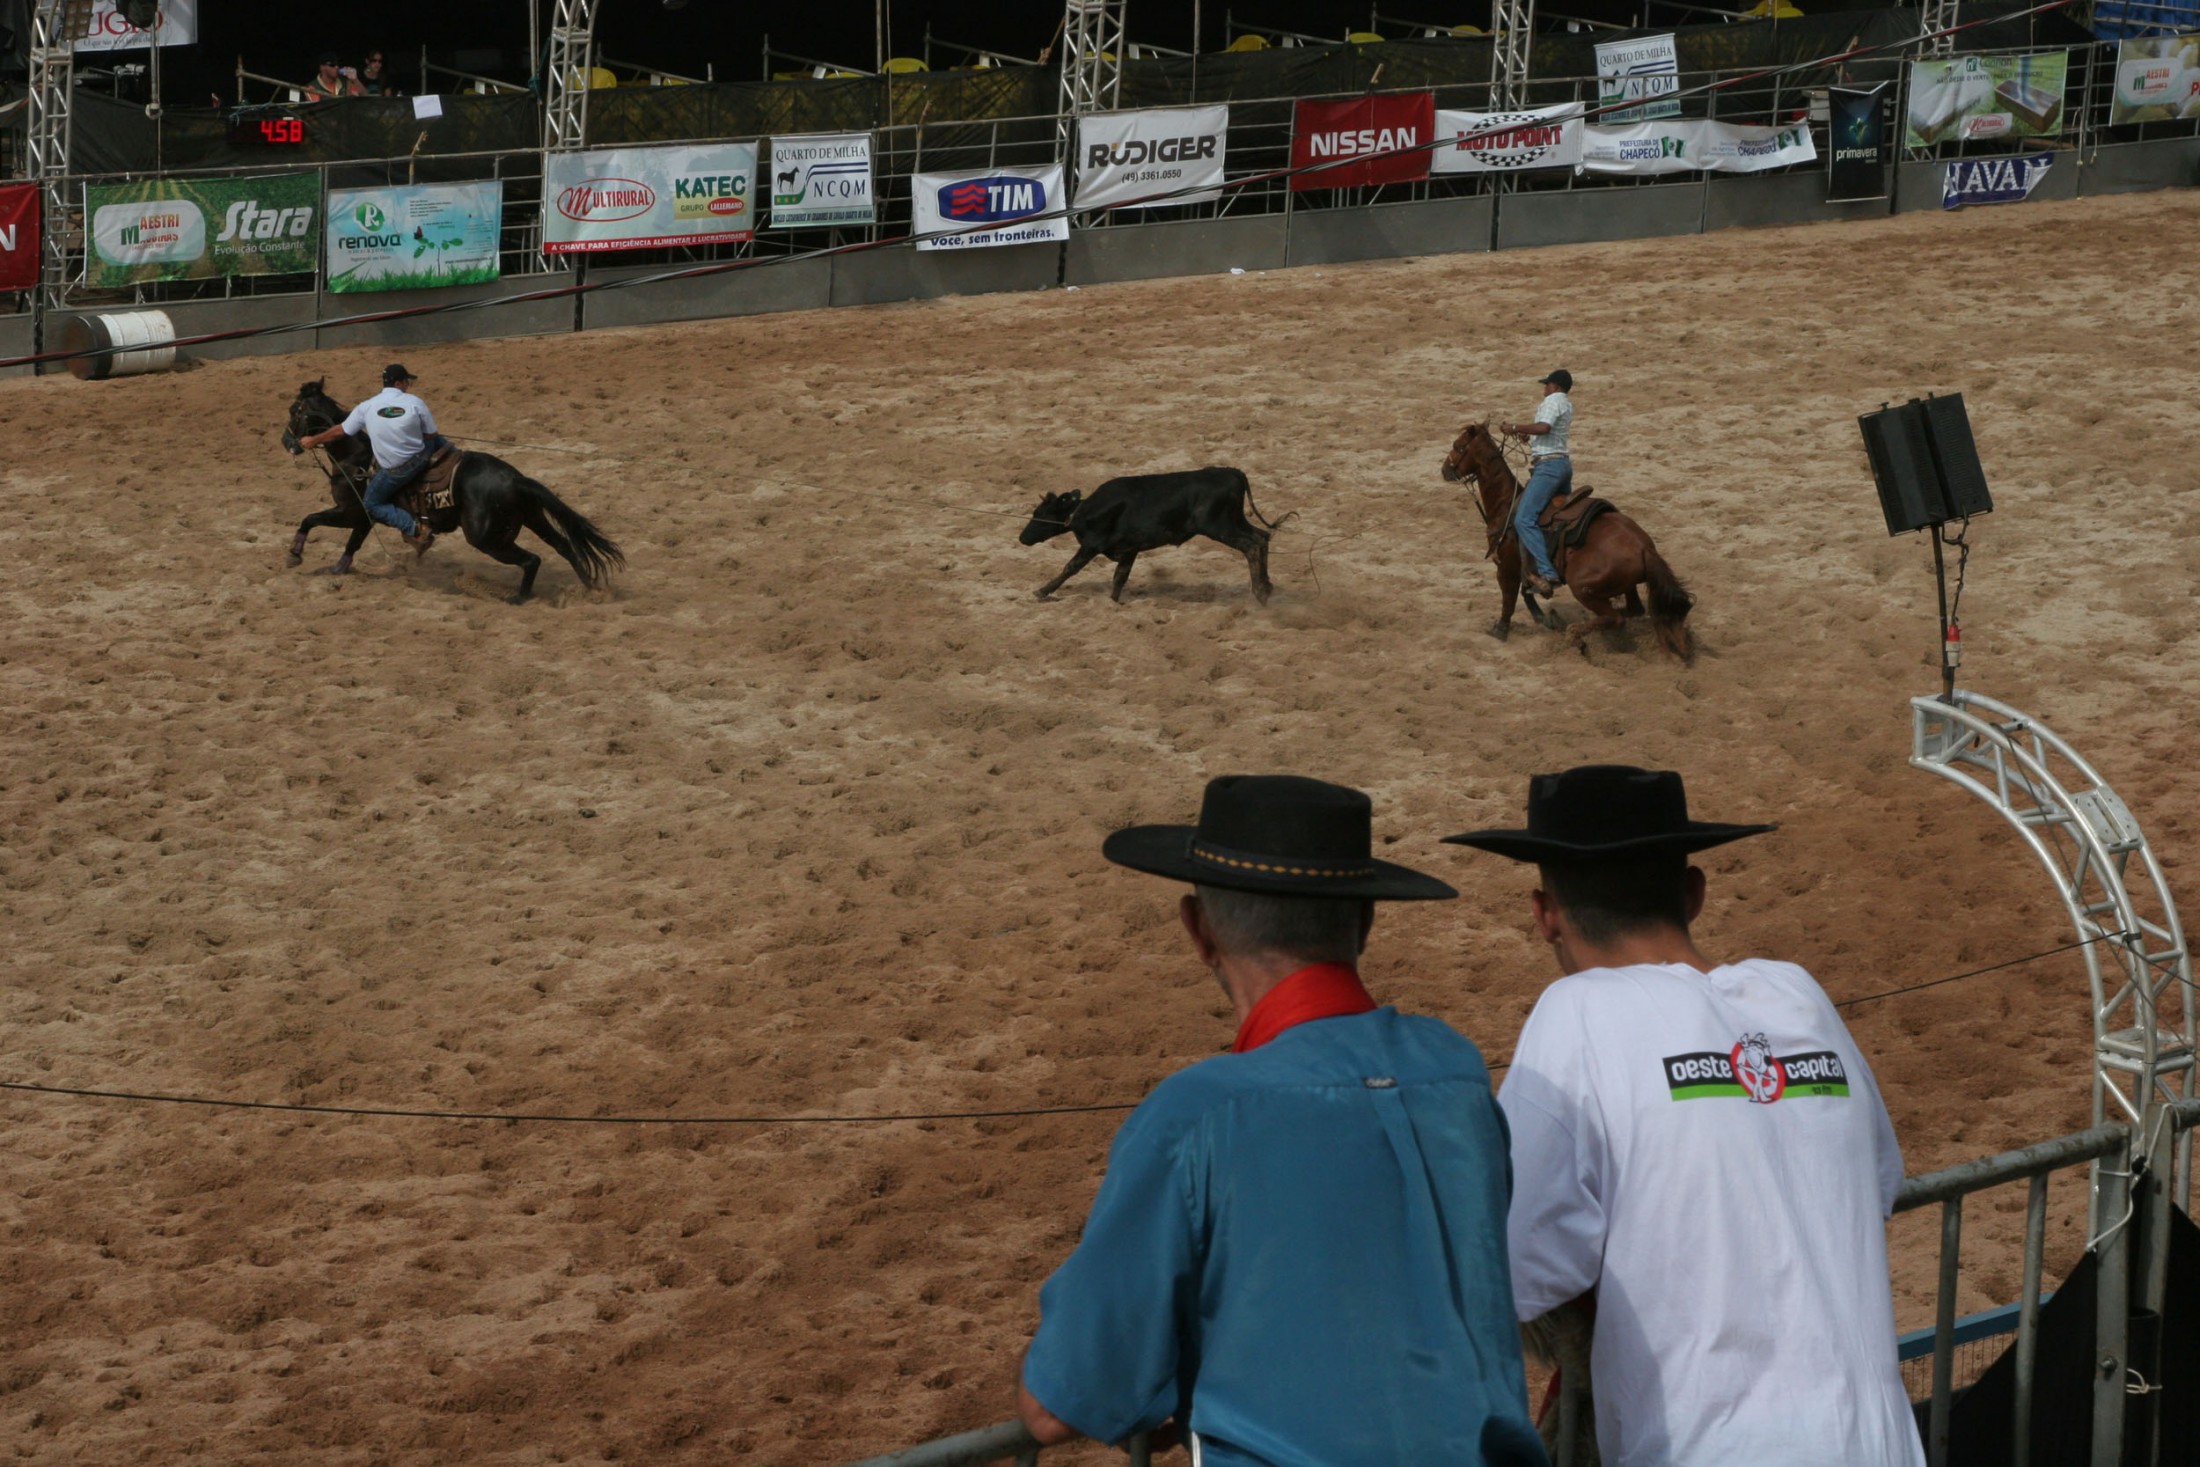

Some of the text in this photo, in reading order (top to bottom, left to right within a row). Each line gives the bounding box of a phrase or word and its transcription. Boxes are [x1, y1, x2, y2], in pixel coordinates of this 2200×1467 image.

[1599, 46, 1672, 67] QUARTO DE MILHA
[1310, 126, 1416, 157] NISSAN
[1456, 125, 1563, 151] MOTO POINT
[776, 146, 866, 163] QUARTO DE MILHA
[1620, 144, 1660, 160] CHAPECÓ
[1836, 147, 1878, 162] primavera
[1121, 169, 1182, 183] (49) 3361.0550
[675, 175, 746, 199] KATEC
[814, 179, 865, 198] NCQM
[565, 186, 650, 216] MULTIRURAL
[680, 201, 743, 213] GRUPO LALLEMAND
[988, 183, 1034, 213] TIM
[215, 200, 313, 242] Stara
[338, 234, 401, 249] renova
[559, 242, 586, 251] CHAVE
[588, 241, 609, 250] PARA
[610, 238, 651, 248] EFICIÊNCIA
[653, 236, 690, 246] ALIMENTAR
[698, 232, 747, 243] LUCRATIVIDADE
[968, 233, 990, 244] sem
[994, 229, 1055, 242] fronteiras.
[214, 240, 305, 256] Evolução Constante
[1671, 1055, 1844, 1081] oeste capital
